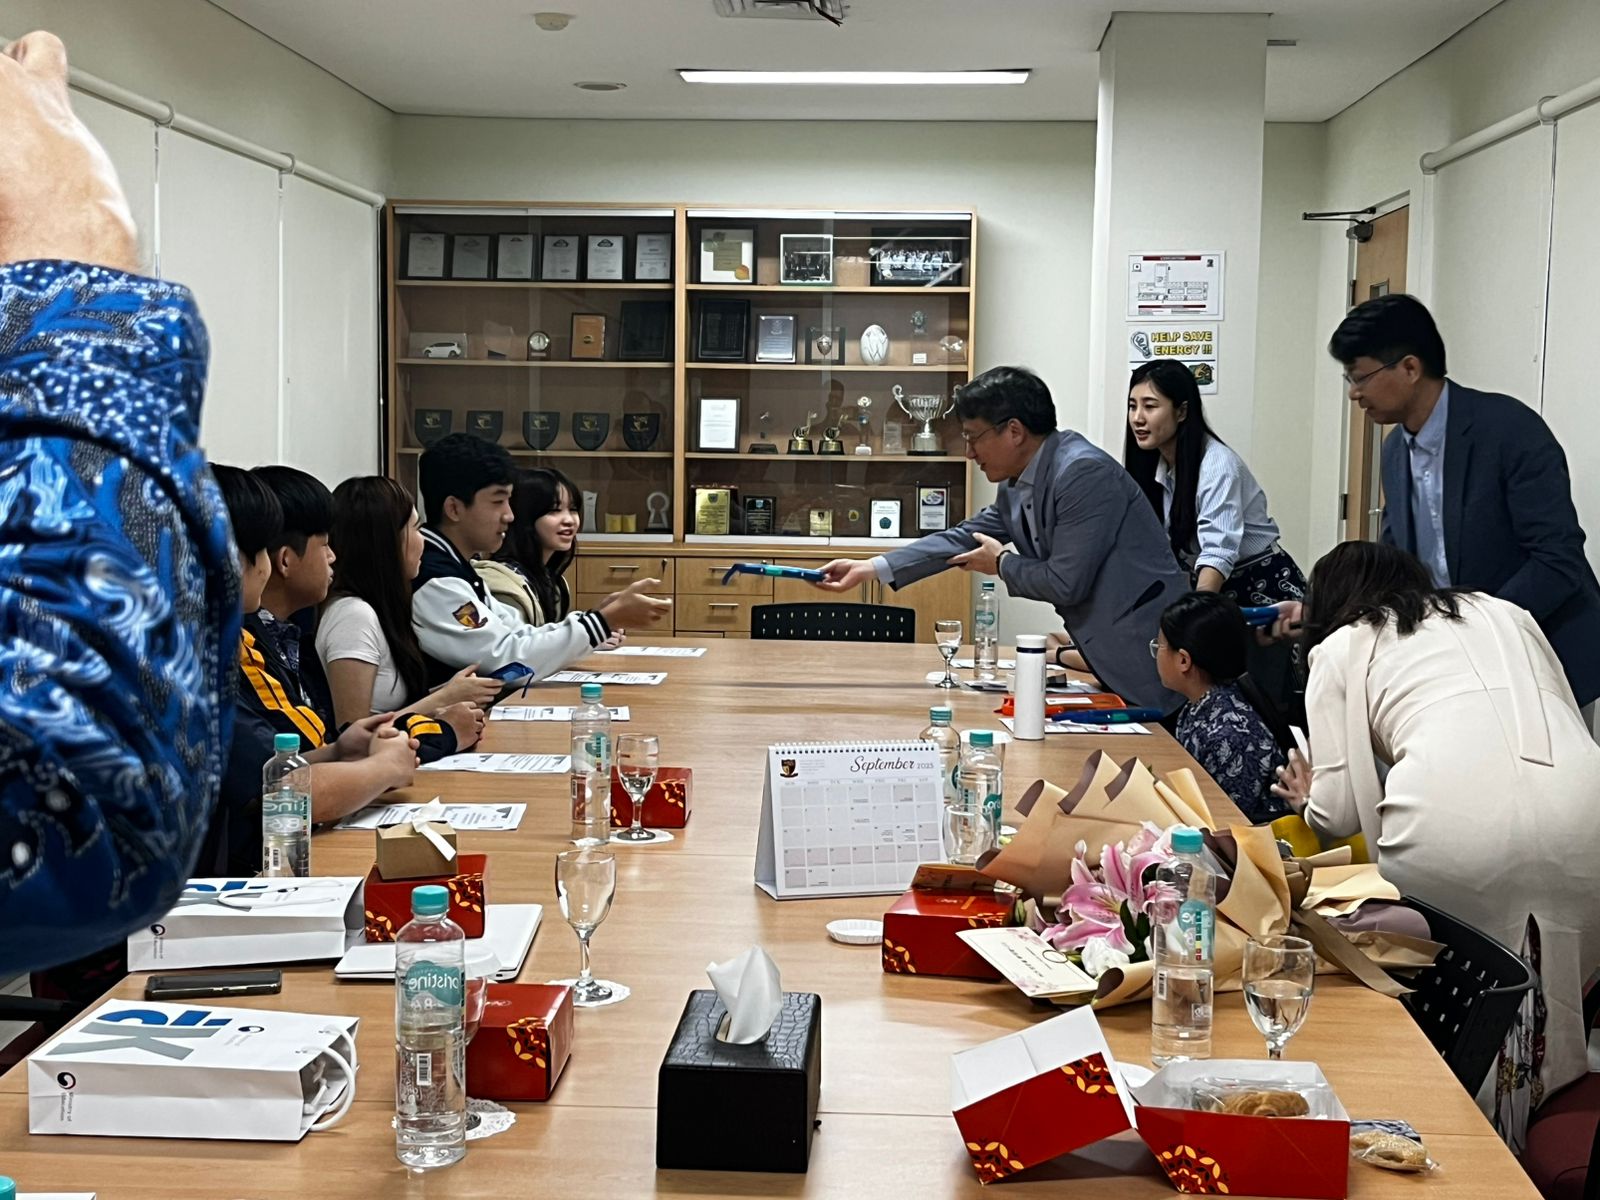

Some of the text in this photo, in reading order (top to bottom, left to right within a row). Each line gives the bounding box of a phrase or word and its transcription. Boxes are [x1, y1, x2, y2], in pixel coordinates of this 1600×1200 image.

[1151, 331, 1213, 343] HELP SAVE
[1154, 344, 1212, 356] ENERGY !!!
[850, 755, 915, 774] September
